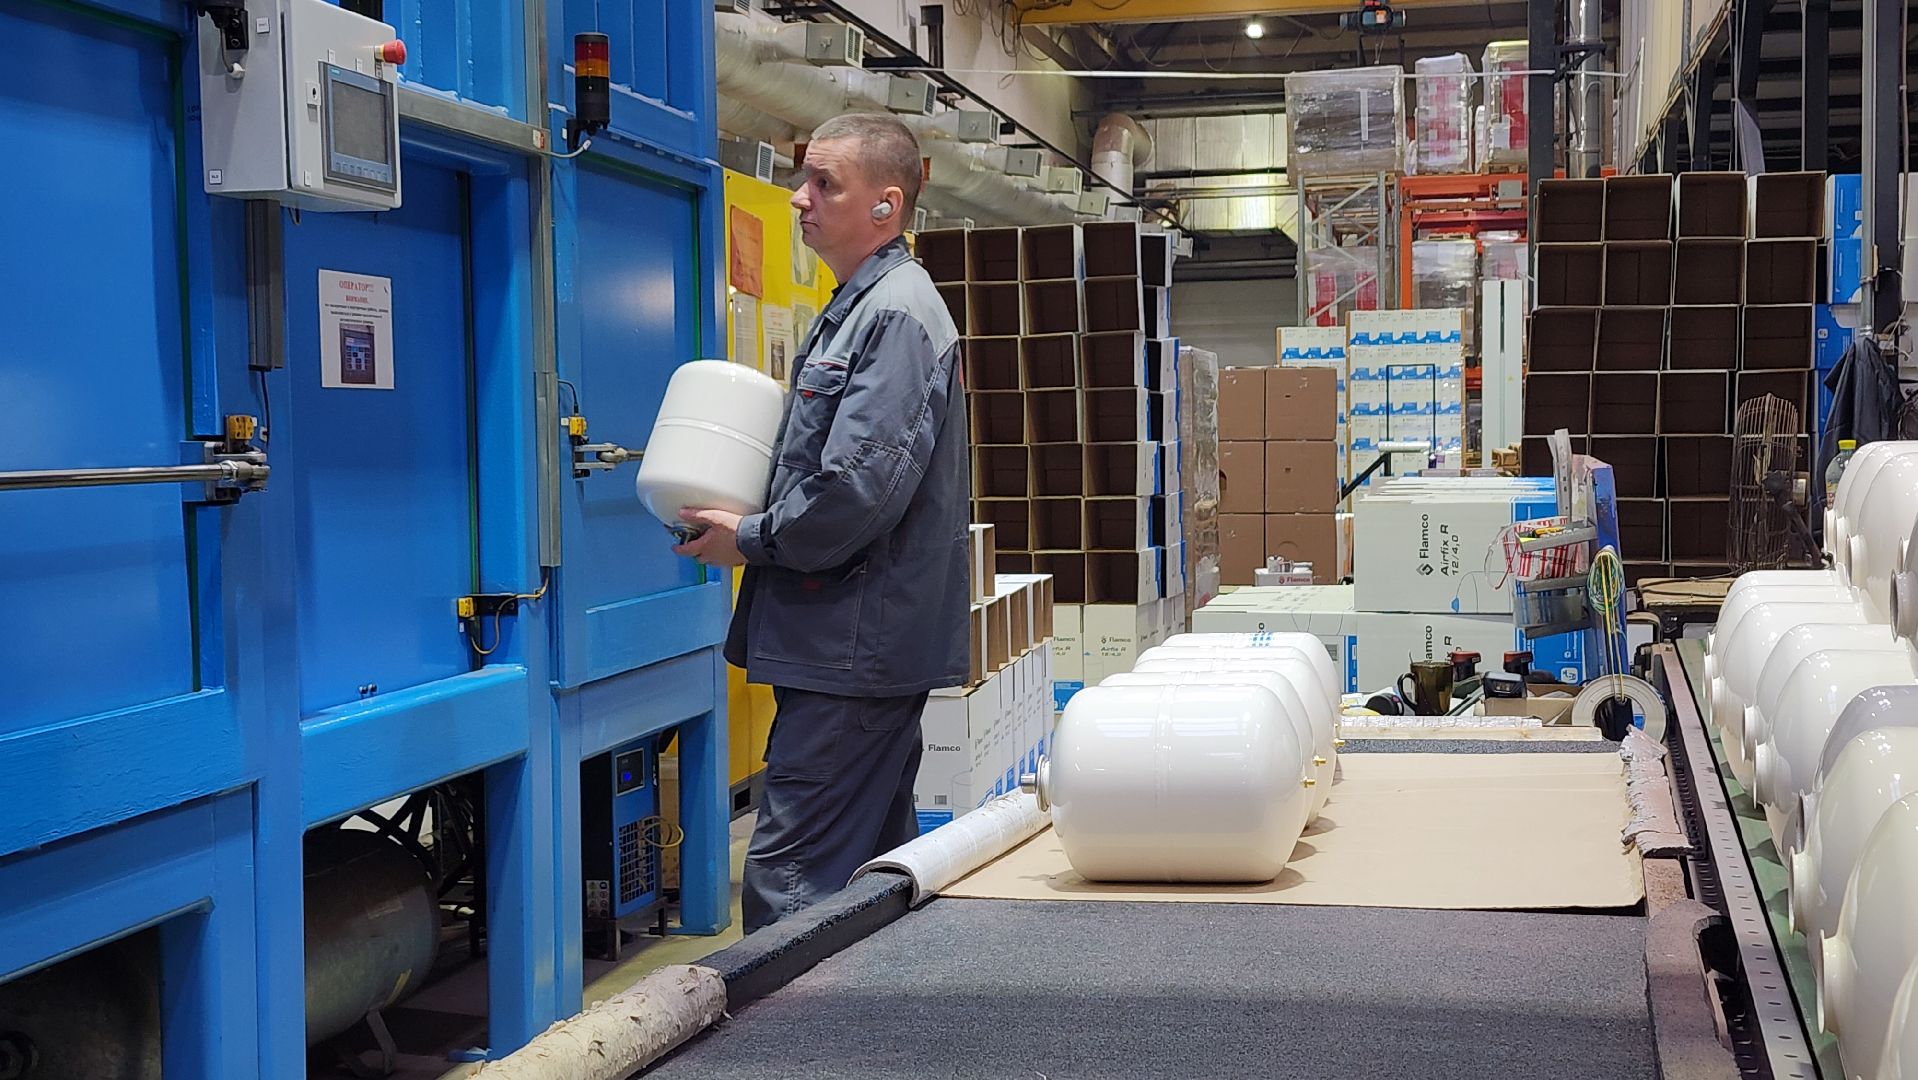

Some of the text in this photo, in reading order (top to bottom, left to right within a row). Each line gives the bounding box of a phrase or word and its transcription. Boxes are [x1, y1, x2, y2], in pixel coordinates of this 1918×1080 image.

[1419, 514, 1429, 558] Flamco
[1440, 524, 1449, 576] Airfix R
[1451, 535, 1460, 575] 12/4,0
[1425, 625, 1433, 662] amco
[1444, 636, 1452, 646] R
[928, 743, 961, 752] Flamco
